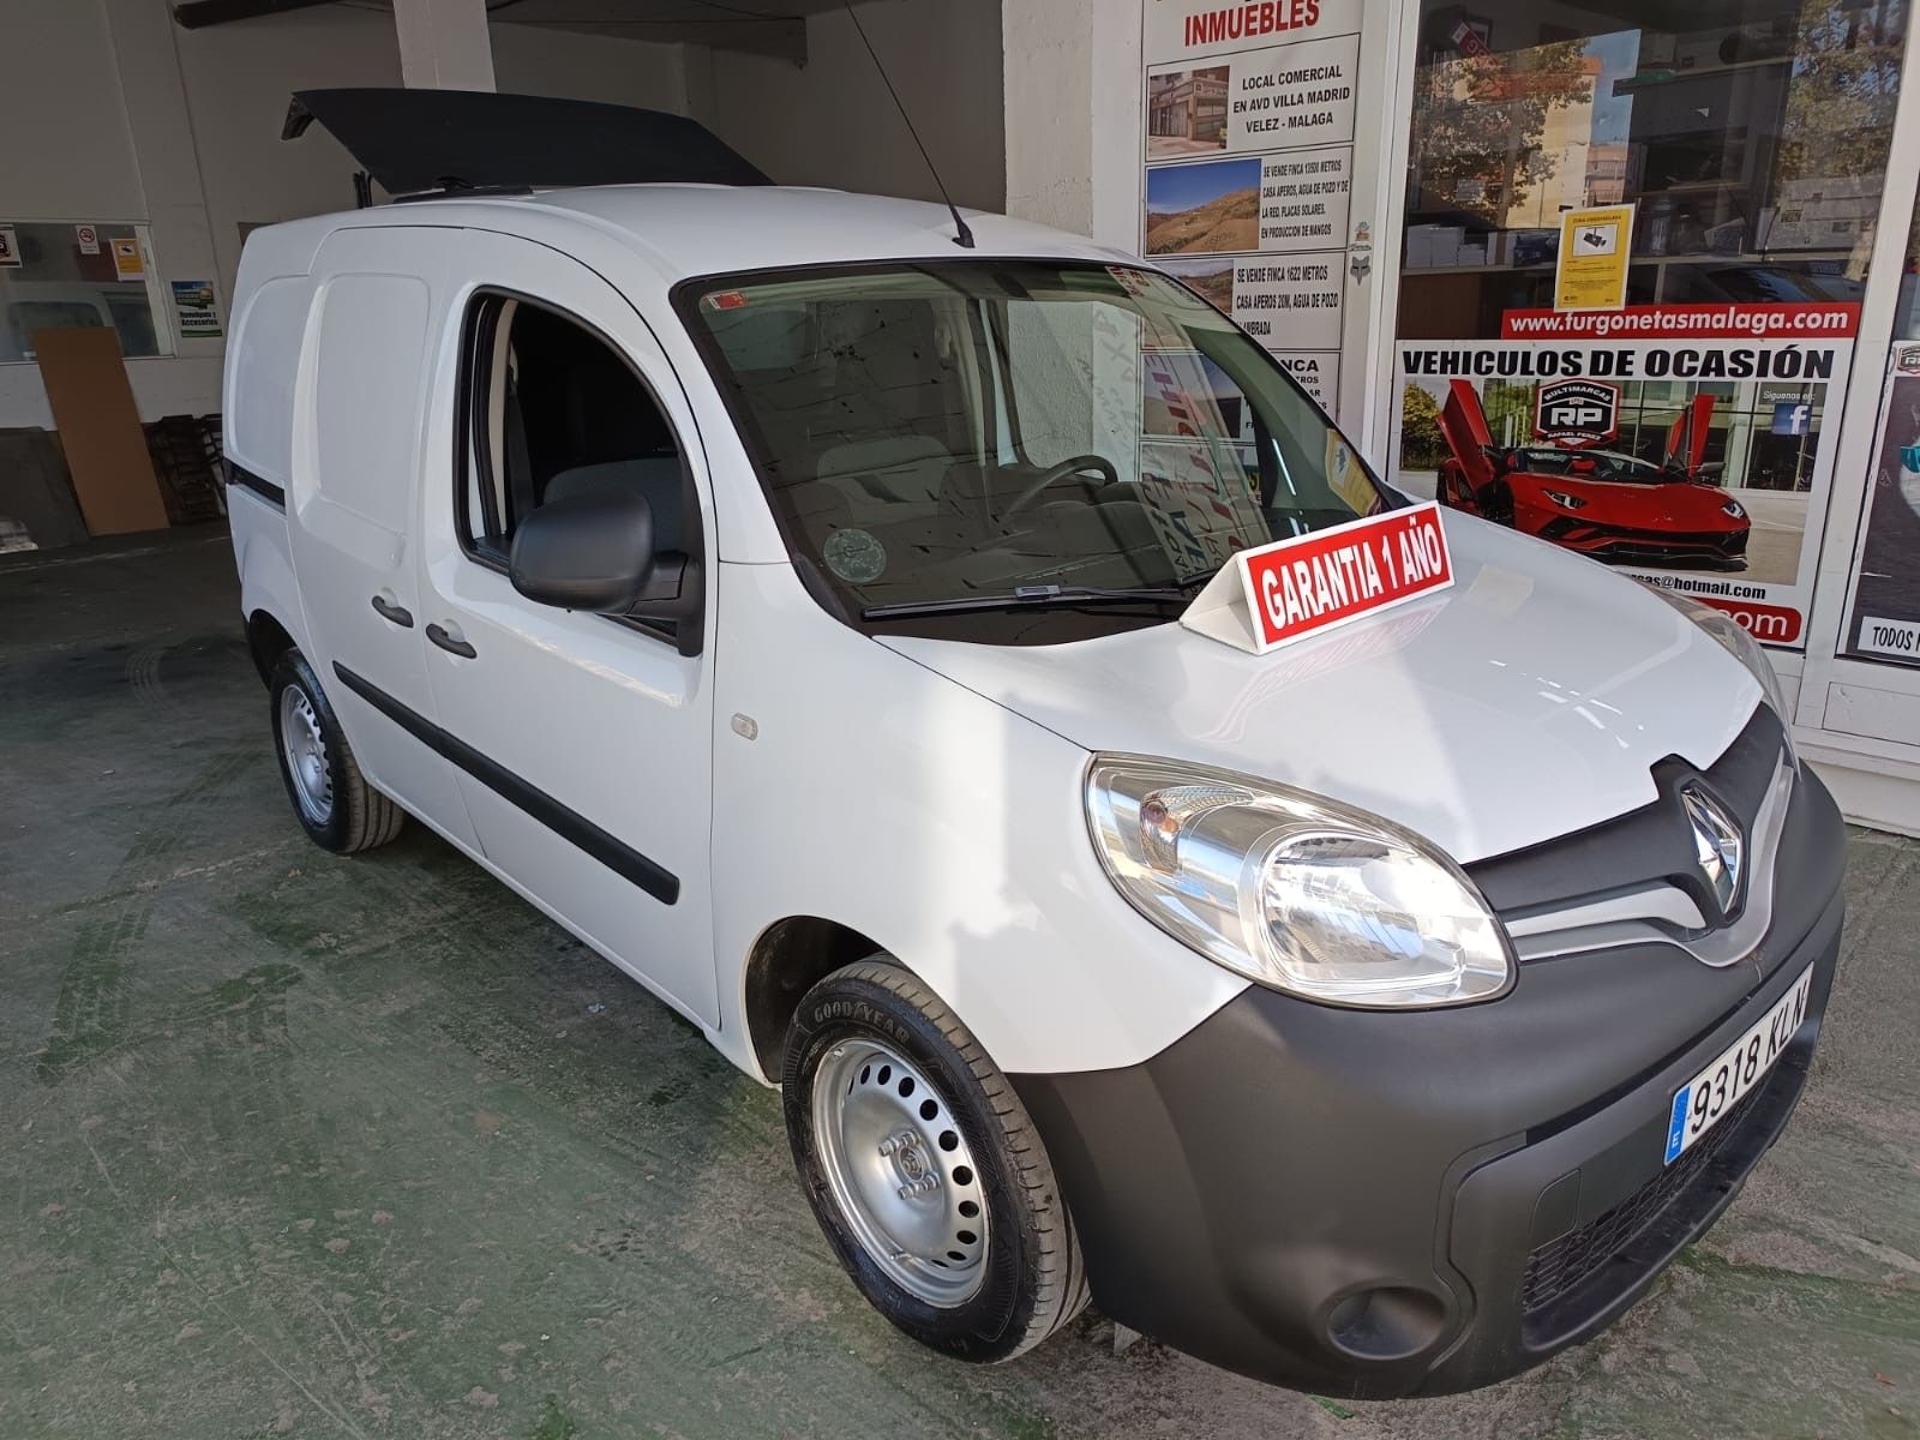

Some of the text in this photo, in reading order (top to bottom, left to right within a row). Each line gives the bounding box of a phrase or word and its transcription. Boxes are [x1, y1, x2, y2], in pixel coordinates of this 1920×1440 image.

[1184, 0, 1320, 47] INMUEBLES
[1242, 65, 1343, 91] LOCAL COMERCIAL
[1233, 87, 1351, 113] EN AVD VILLA MADRID
[1246, 118, 1279, 133] VELEZ
[1288, 112, 1333, 129] MALAGA
[1263, 166, 1270, 178] SE
[1271, 164, 1287, 178] VENDE
[1288, 163, 1303, 176] FINCA
[1320, 159, 1342, 173] METROS
[1263, 186, 1276, 198] CASA
[1299, 183, 1312, 195] AGUA
[1314, 182, 1320, 194] DE
[1322, 181, 1336, 193] POZO
[1336, 181, 1340, 192] Y
[1341, 180, 1348, 192] DE
[1262, 207, 1268, 219] LA
[1281, 205, 1300, 218] PLACAS
[1261, 223, 1332, 239] EN PRODUCCION DE MANGOS
[1237, 268, 1245, 283] SE
[1246, 267, 1266, 282] VENDE
[1267, 266, 1285, 282] FINCA
[1302, 264, 1328, 281] METROS
[1236, 295, 1252, 310] CASA
[1253, 294, 1276, 309] APEROS
[1293, 293, 1310, 308] AGUA
[1311, 293, 1320, 308] DE
[1320, 292, 1339, 308] POZO
[1510, 307, 1848, 336] www.furgonetasmalaga.com
[1402, 344, 1835, 378] VEHICULOS DE OCASIÓN
[1543, 385, 1611, 402] MULTIMARCAS
[1550, 407, 1603, 426] RP
[1261, 515, 1443, 630] GARANTIA 1 AÑO
[1872, 626, 1915, 651] TODOS
[1691, 978, 1808, 1135] 9318 KLN
